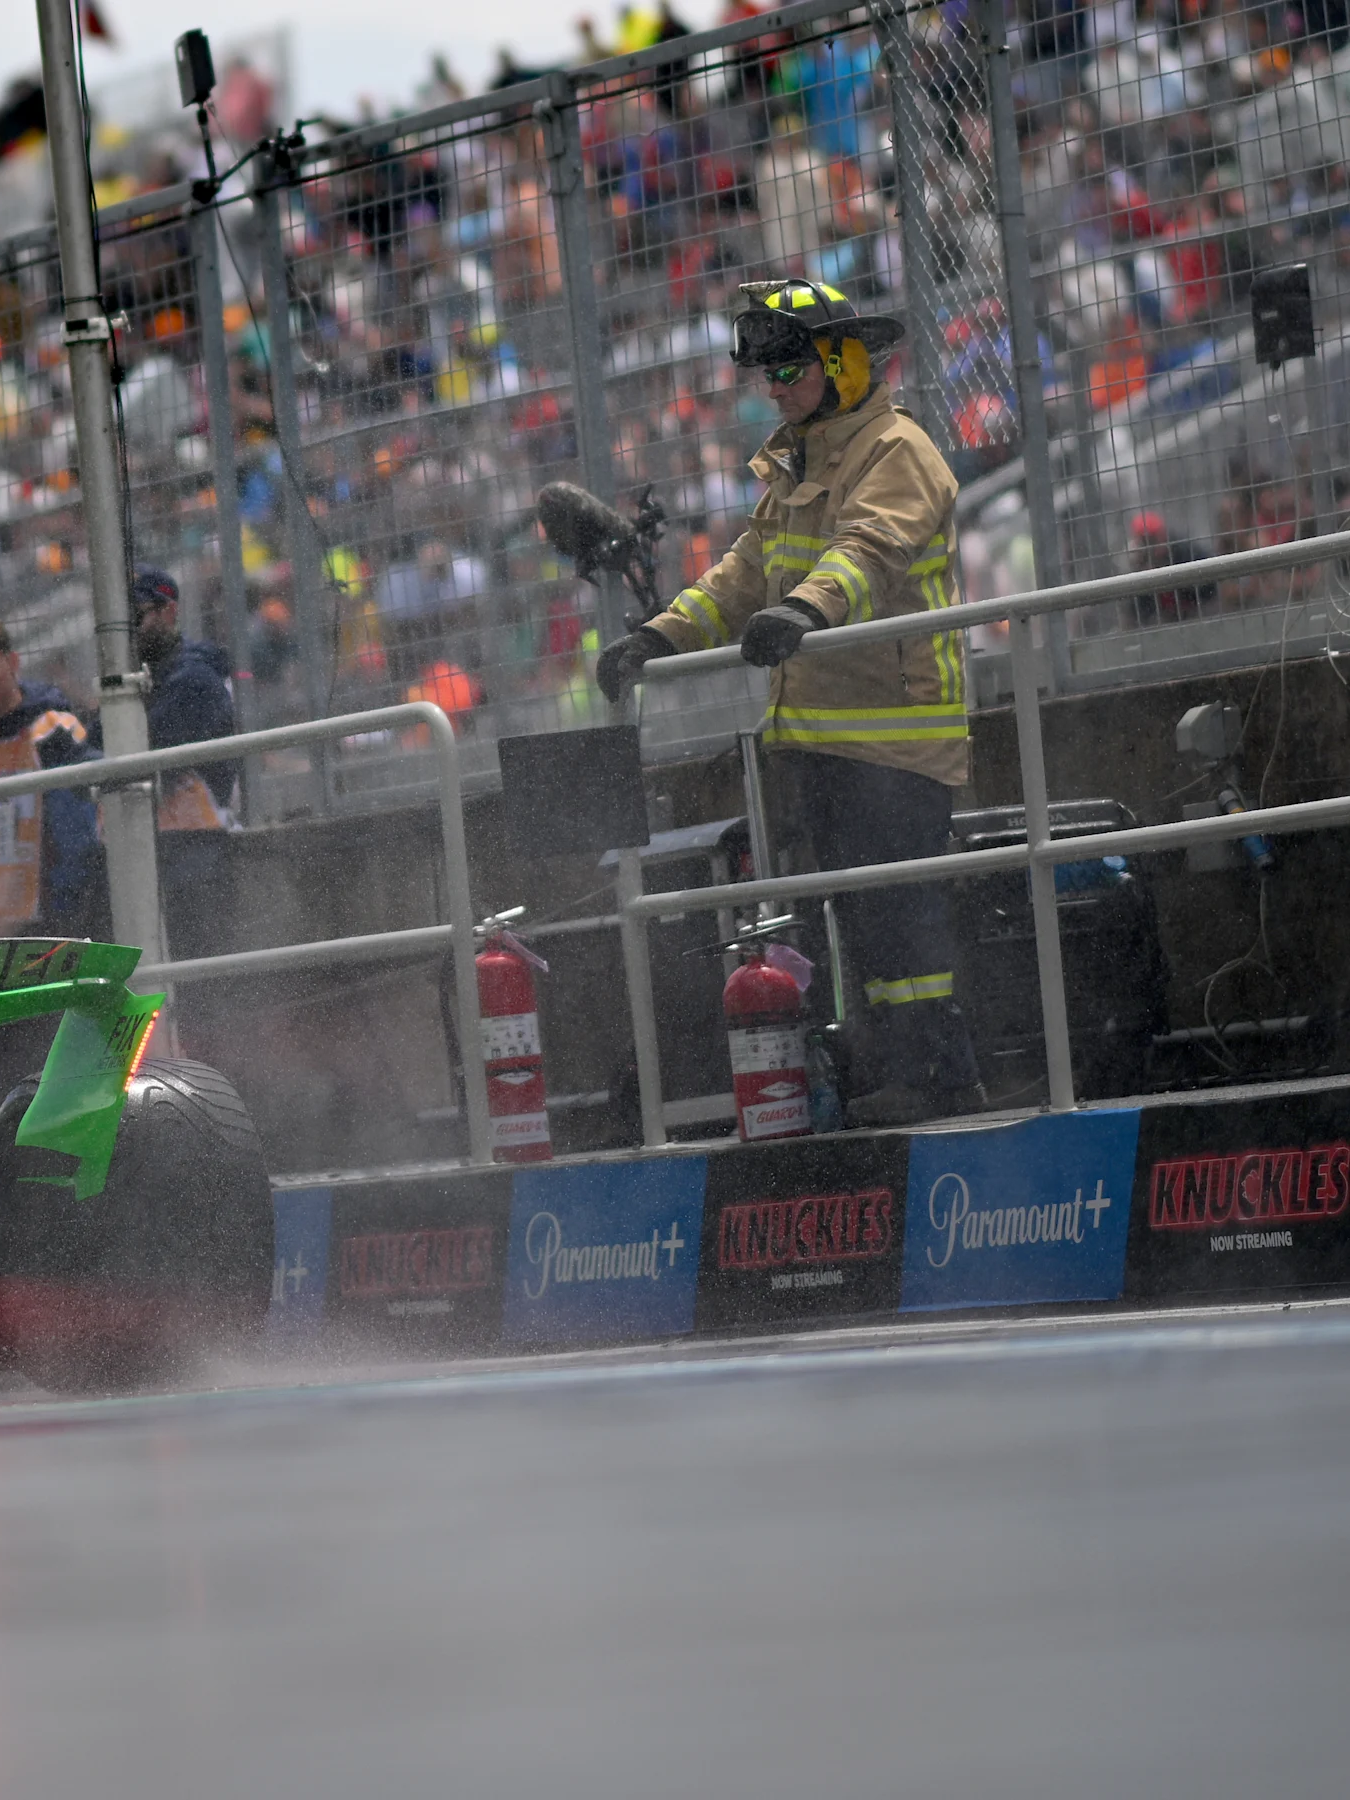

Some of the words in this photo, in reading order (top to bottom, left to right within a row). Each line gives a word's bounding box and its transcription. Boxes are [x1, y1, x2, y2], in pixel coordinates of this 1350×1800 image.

[927, 1172, 1111, 1268] Paramount+
[1150, 1146, 1350, 1228] KNUCKLES
[524, 1211, 685, 1299] Paramount+
[720, 1191, 892, 1266] KNUCKLES
[1210, 1236, 1234, 1252] NOW
[1236, 1231, 1293, 1250] STREAMING
